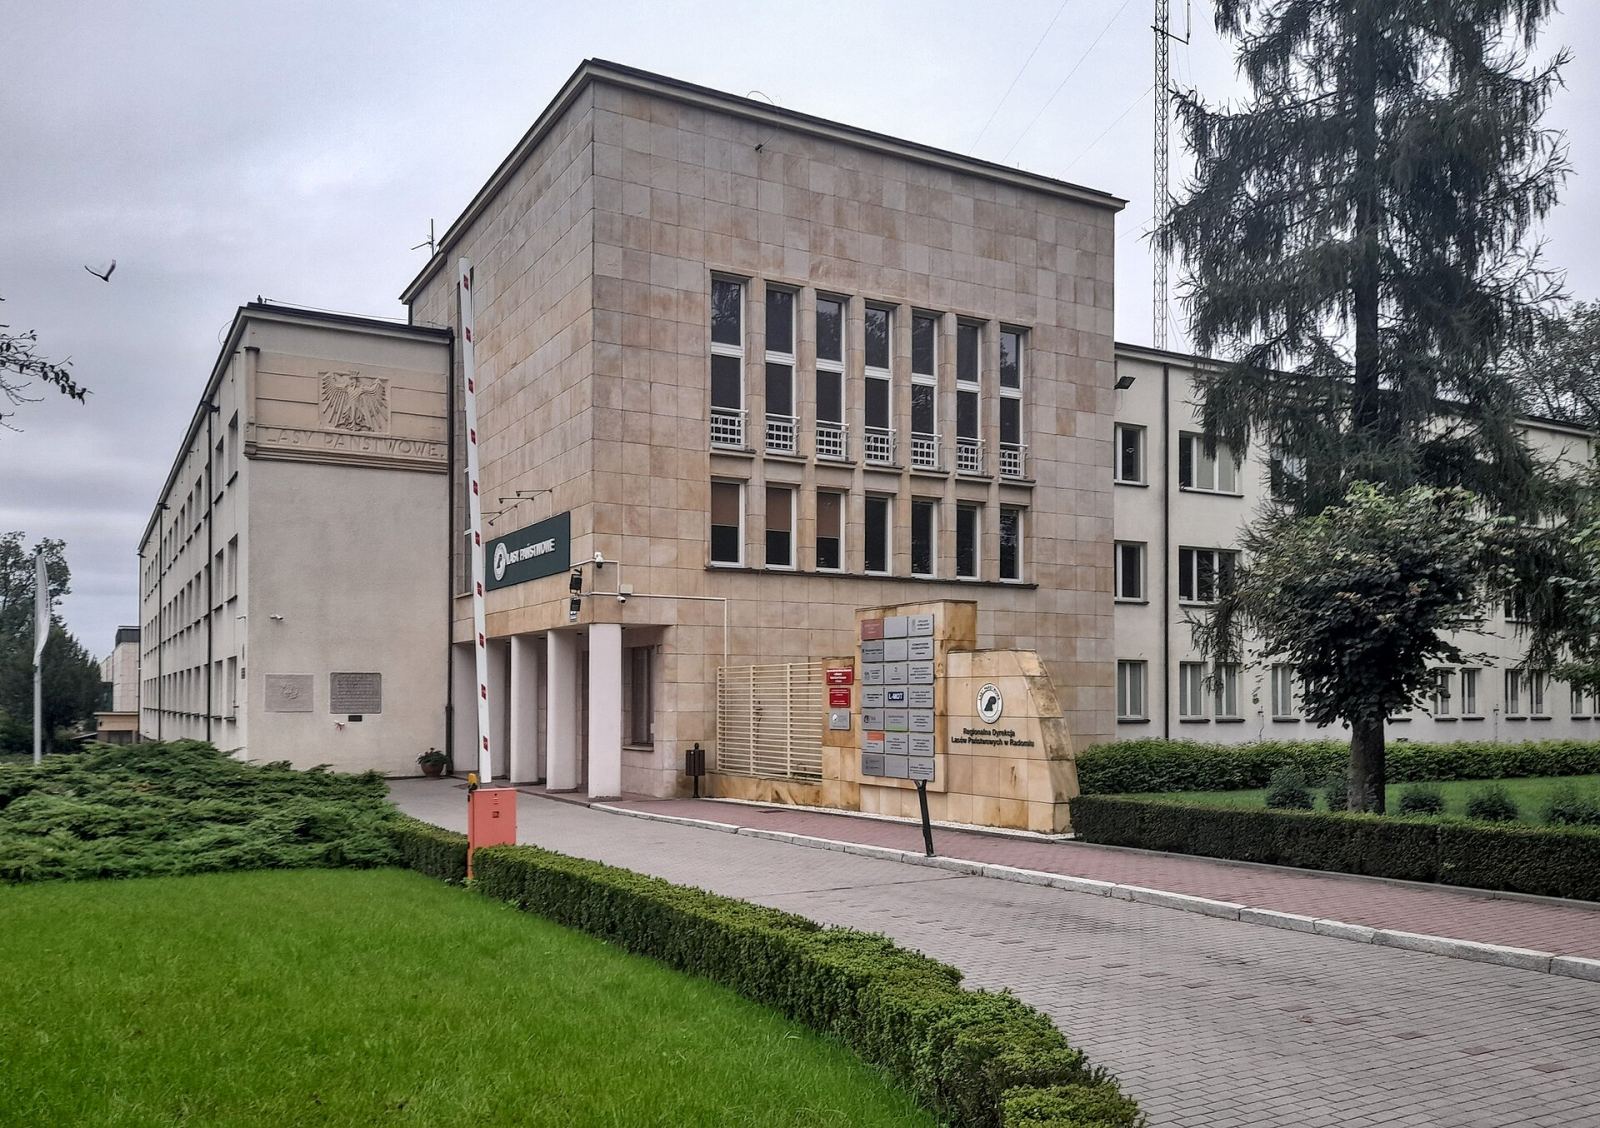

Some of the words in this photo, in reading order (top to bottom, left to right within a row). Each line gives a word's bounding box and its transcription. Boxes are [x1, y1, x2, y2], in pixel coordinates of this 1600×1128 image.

[963, 728, 992, 737] Regionalna
[992, 729, 1016, 738] Dyrekcja
[951, 736, 967, 744] Lasów
[967, 737, 1003, 747] Państwowych
[1009, 739, 1035, 747] Radomiu
